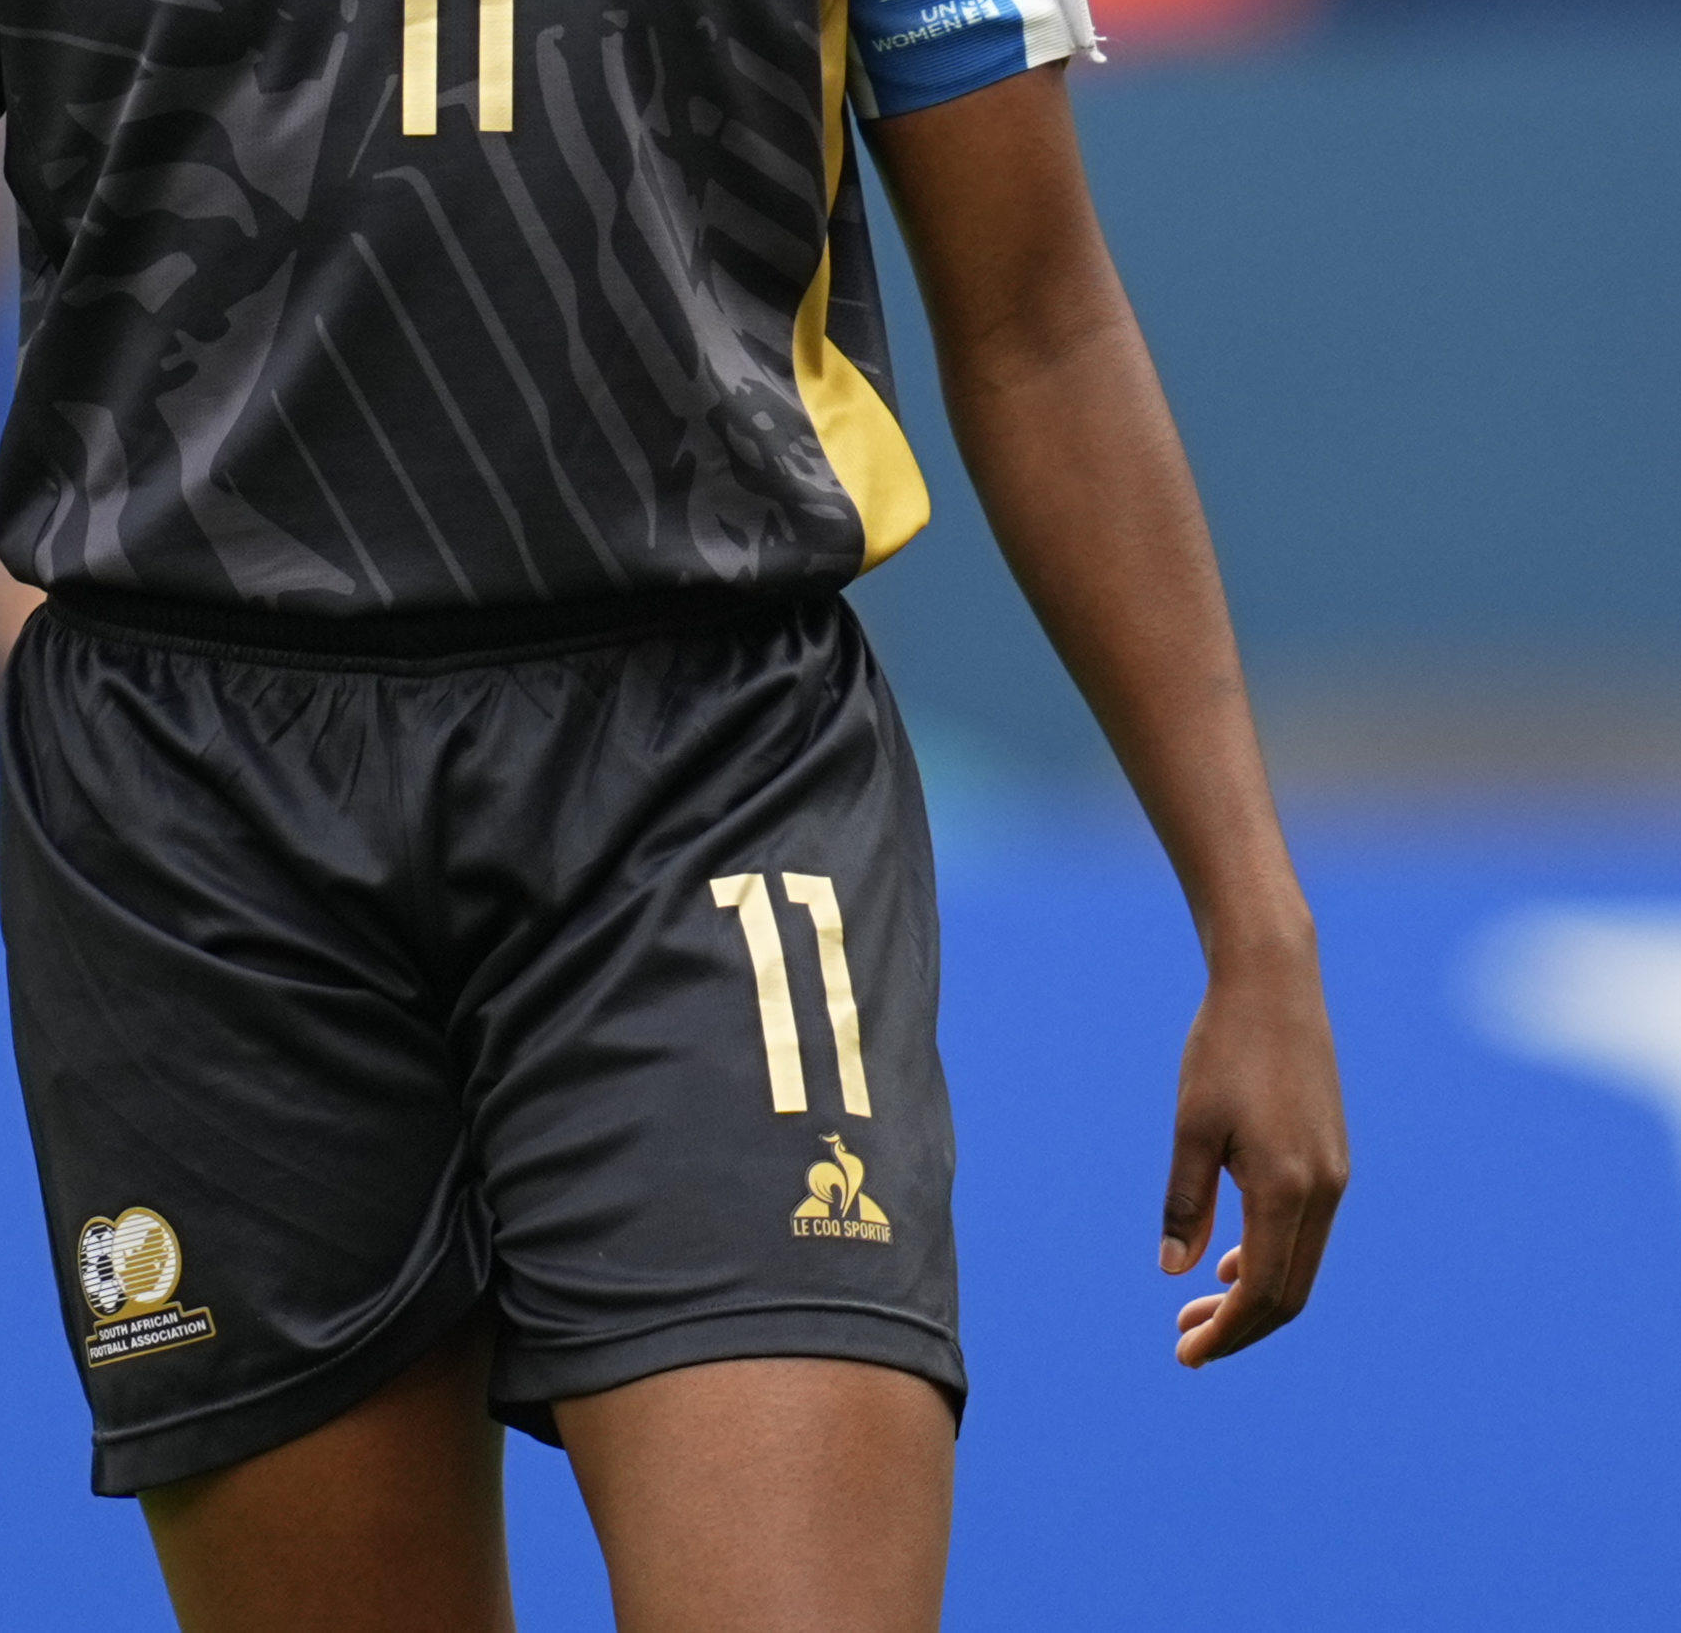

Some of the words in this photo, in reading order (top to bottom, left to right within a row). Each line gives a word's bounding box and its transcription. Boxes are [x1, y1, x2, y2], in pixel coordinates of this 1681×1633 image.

[921, 0, 957, 23] UN
[872, 15, 962, 53] WOMEN
[709, 872, 872, 1118] 11
[793, 1219, 810, 1236] LE
[813, 1219, 841, 1236] COQ
[843, 1220, 891, 1243] SPORTIF
[90, 1340, 129, 1359] FOOTBALL
[131, 1319, 207, 1348] ASSOCIATION
[99, 1324, 128, 1341] SOUTH
[131, 1311, 179, 1333] AFRICAN
